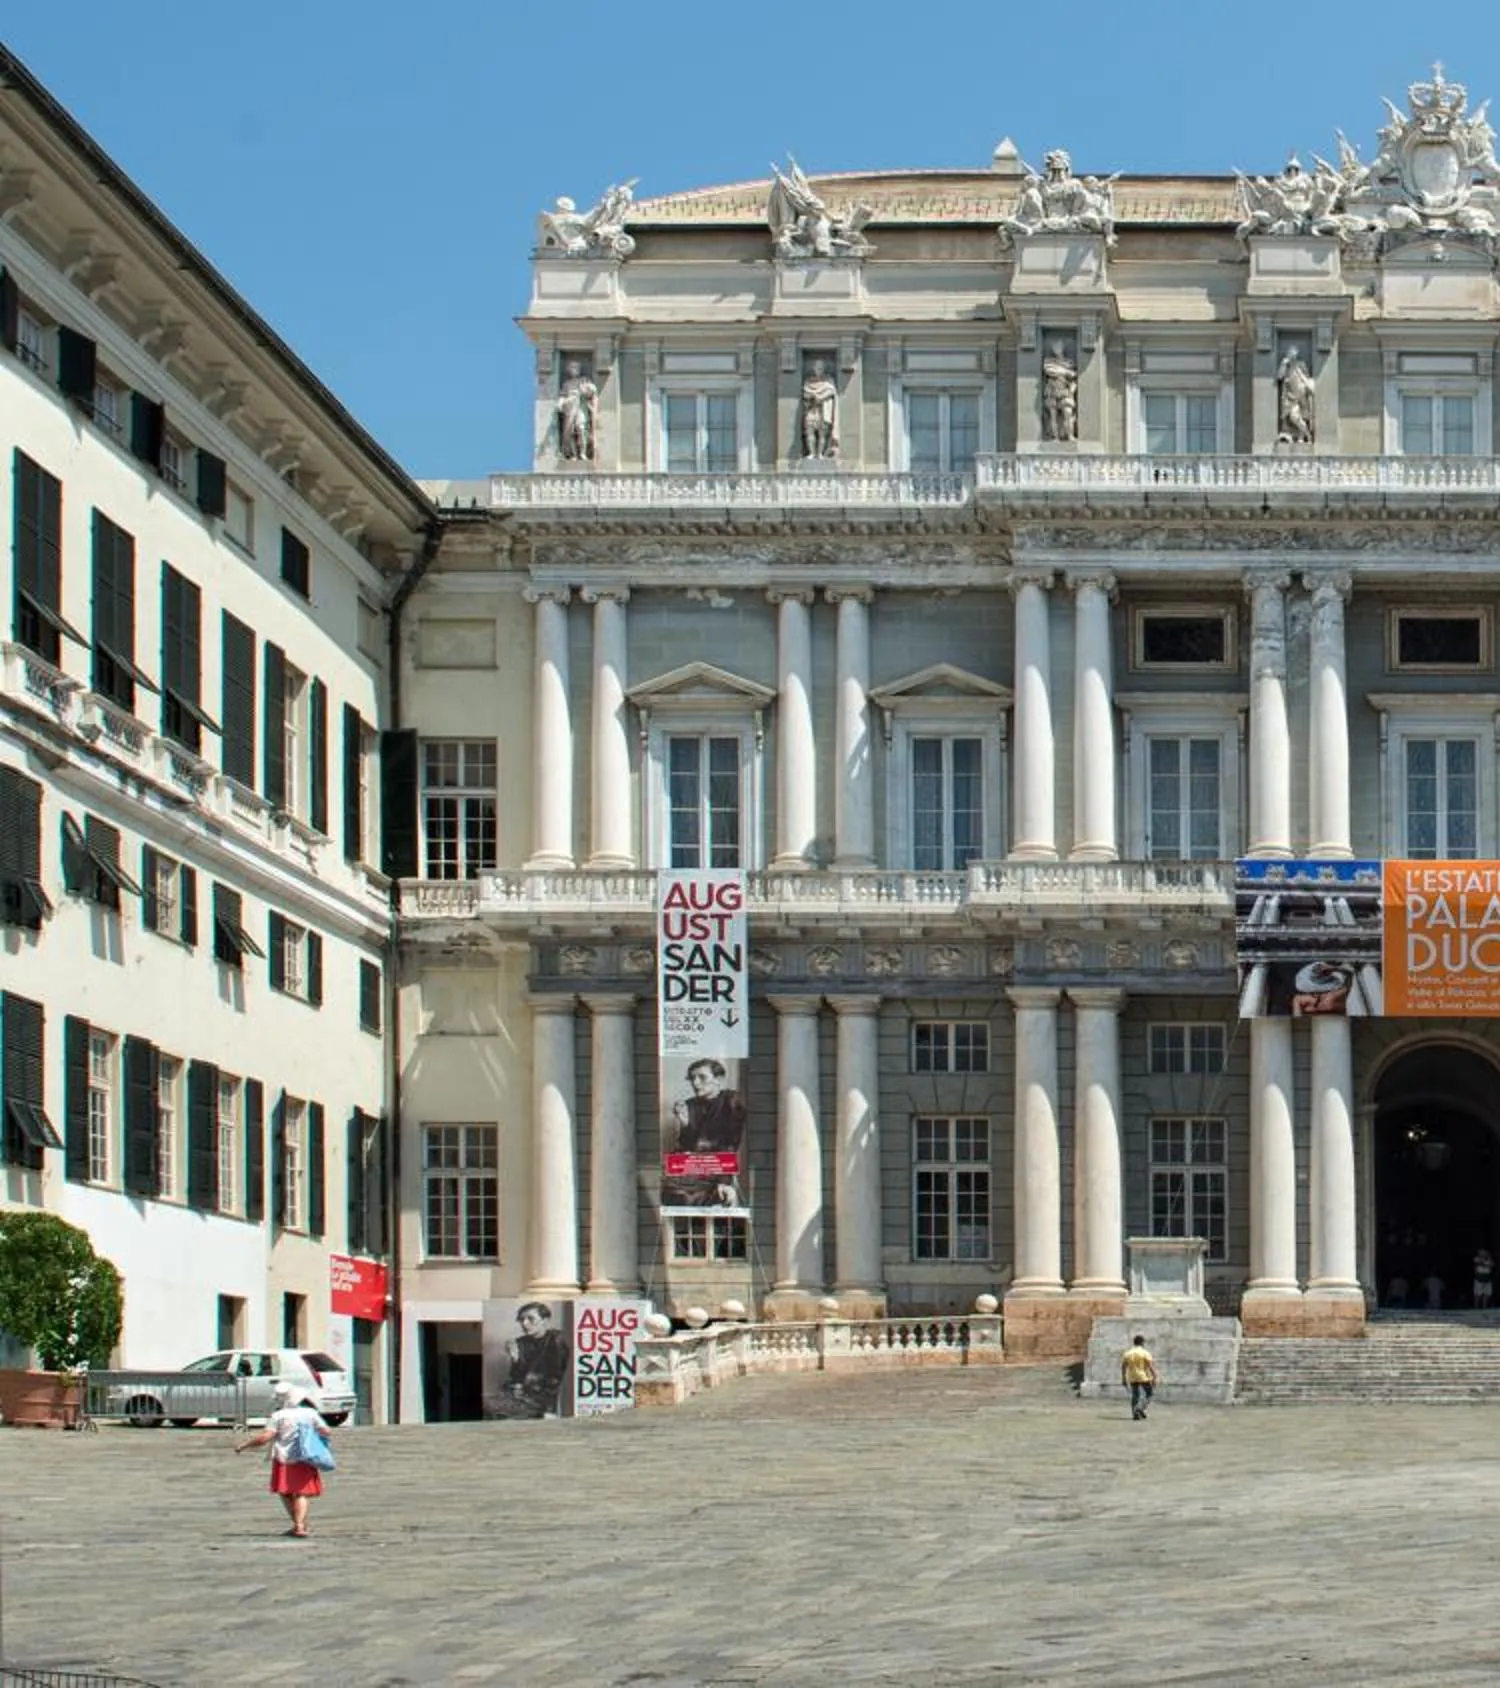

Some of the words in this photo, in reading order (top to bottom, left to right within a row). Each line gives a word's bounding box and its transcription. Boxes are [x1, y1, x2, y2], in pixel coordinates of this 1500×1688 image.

[663, 881, 742, 911] AUG
[663, 912, 733, 941] UST
[663, 943, 742, 973] SAN
[663, 973, 735, 1003] DER
[577, 1308, 639, 1331] AUG
[577, 1331, 632, 1353] UST
[577, 1354, 637, 1376] SAN
[577, 1375, 632, 1398] DER
